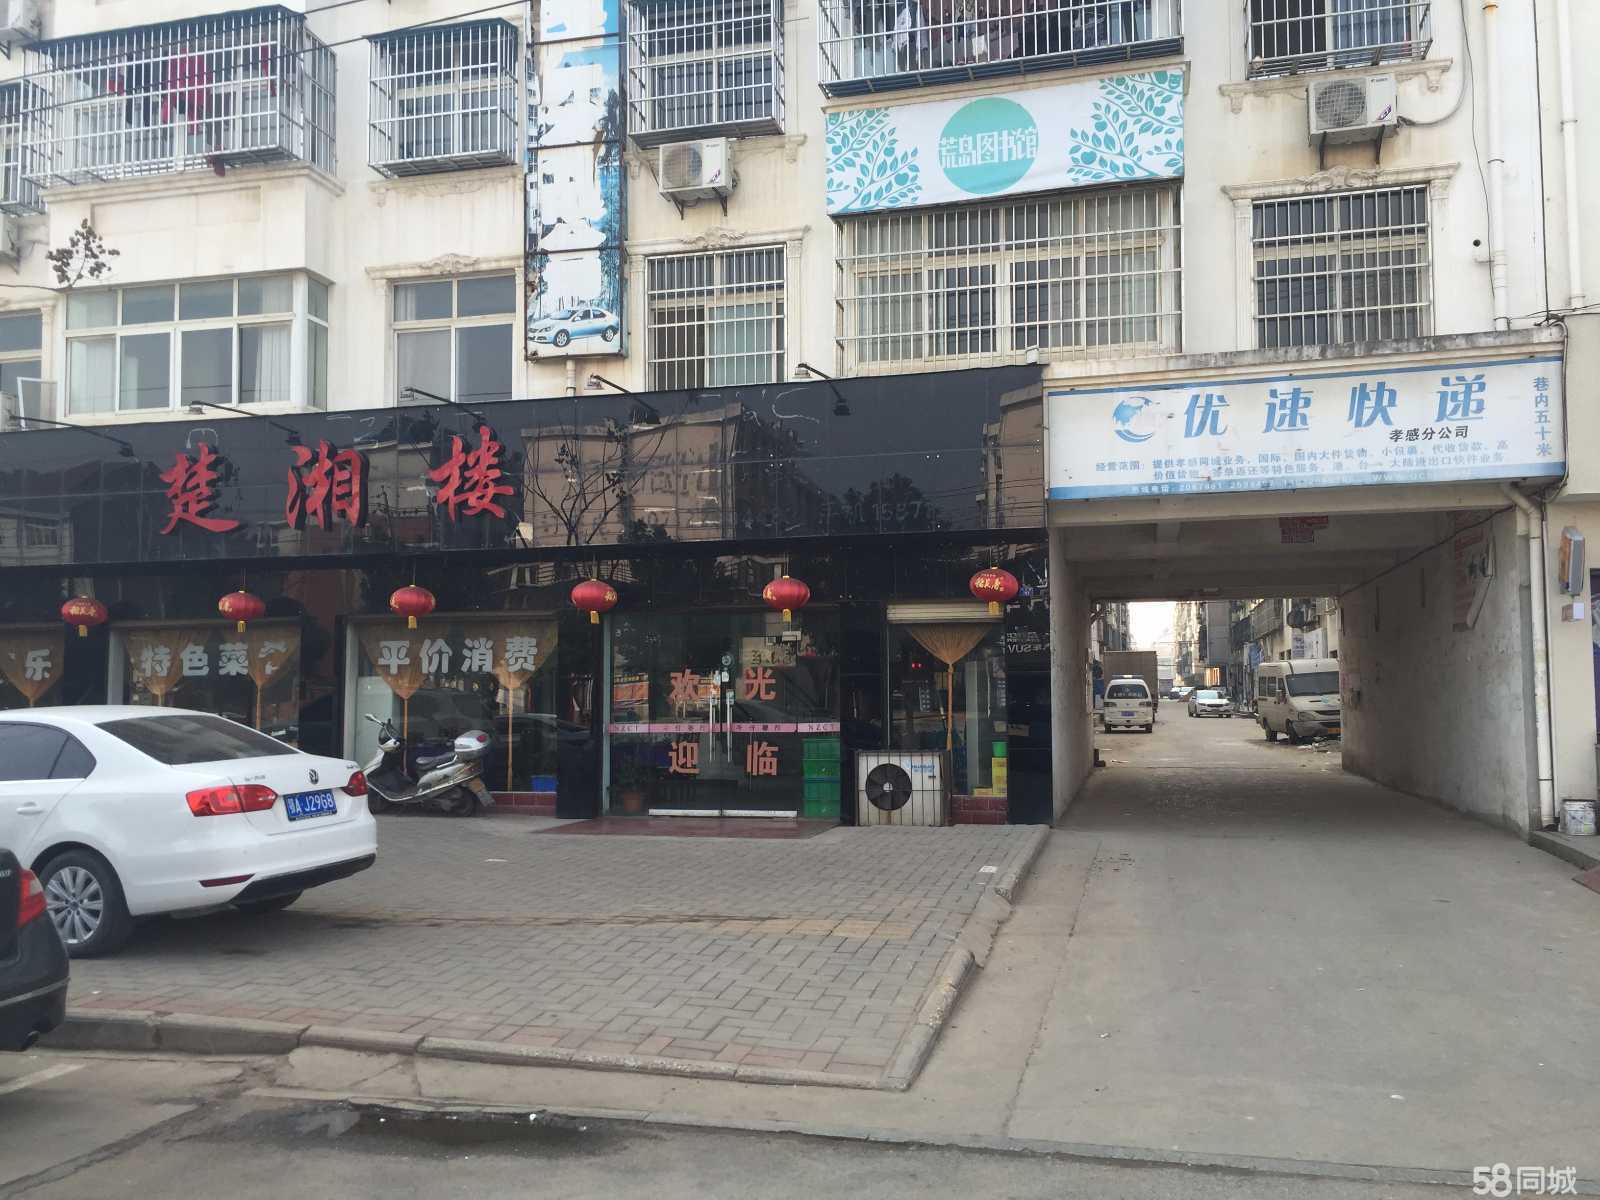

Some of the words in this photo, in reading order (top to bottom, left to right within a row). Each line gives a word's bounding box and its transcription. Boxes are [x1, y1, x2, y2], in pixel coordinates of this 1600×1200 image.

[939, 126, 1038, 168] 荒岛图书馆
[1183, 374, 1487, 438] 优速快递
[1533, 376, 1552, 456] 巷内五十米
[1389, 425, 1469, 442] 孝感分公司
[160, 425, 514, 535] 楚湘楼
[378, 637, 538, 674] 平价消费
